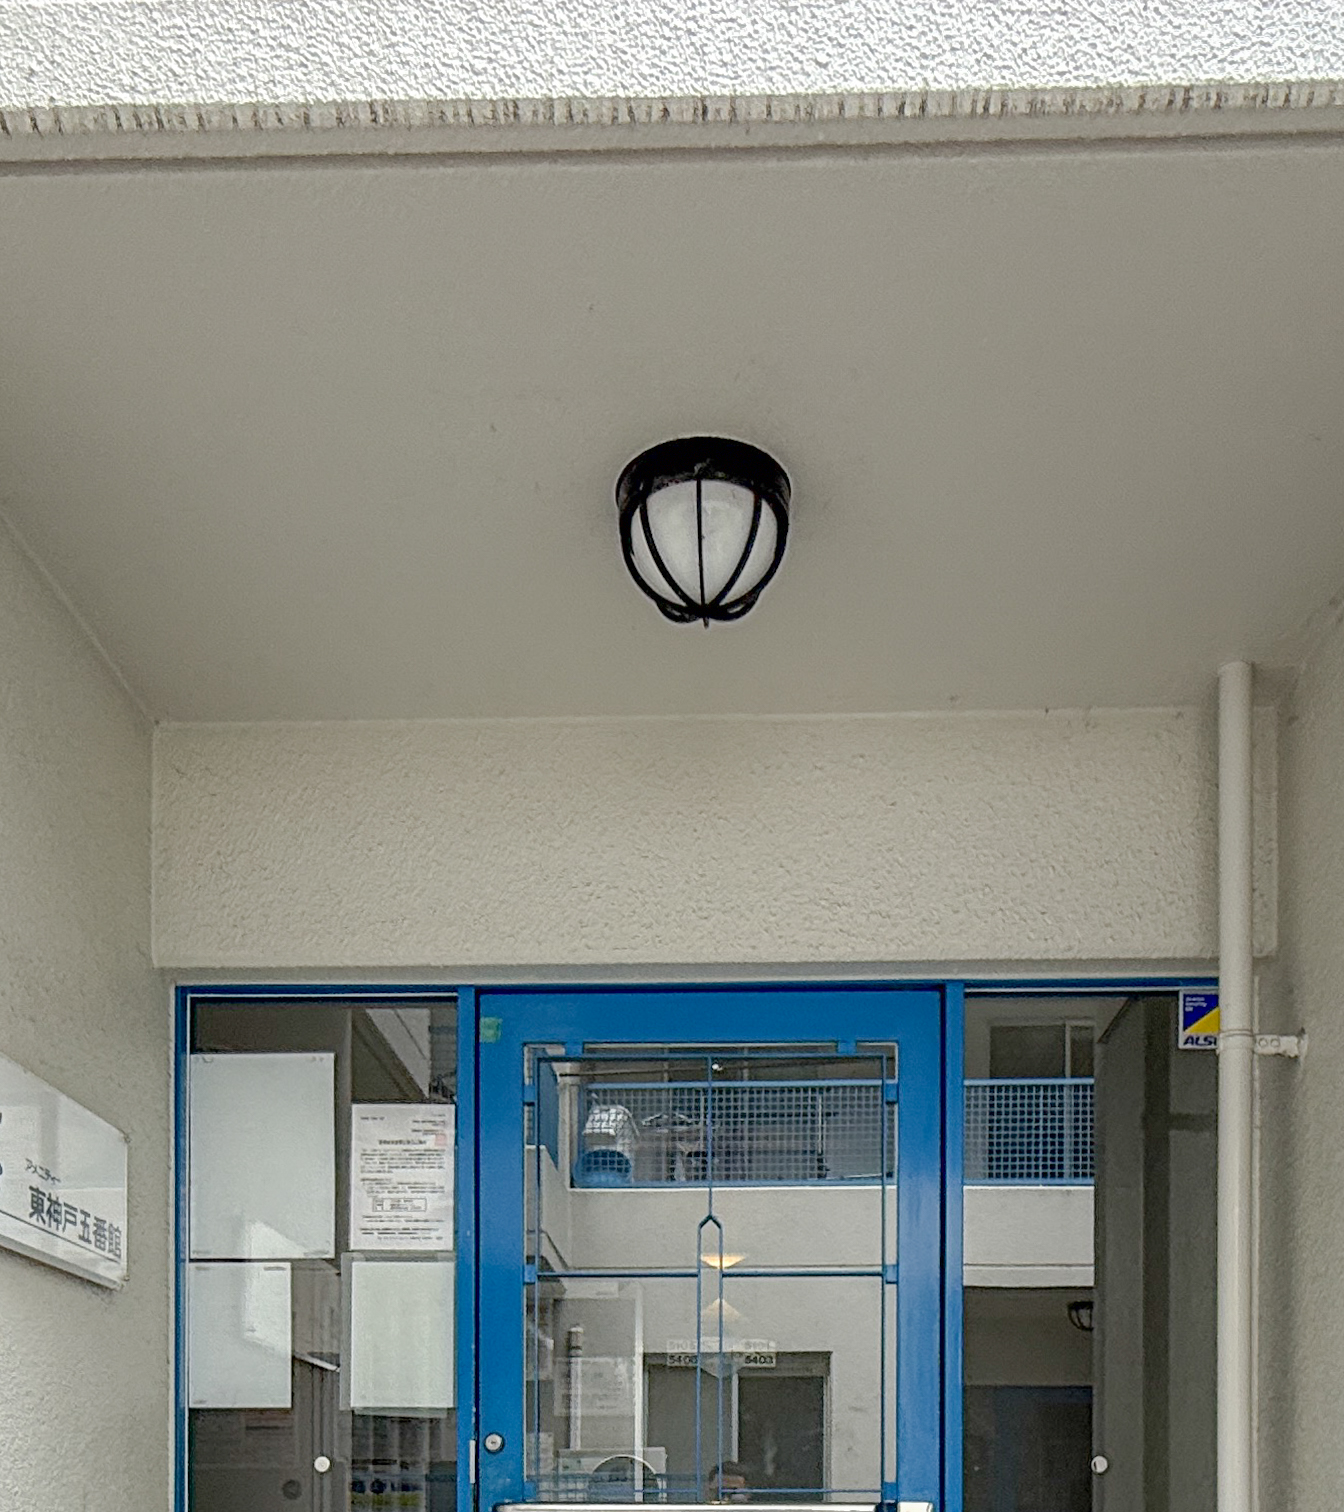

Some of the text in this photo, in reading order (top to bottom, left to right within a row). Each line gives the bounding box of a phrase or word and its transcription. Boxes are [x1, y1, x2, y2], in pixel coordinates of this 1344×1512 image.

[29, 1185, 122, 1259] 東神戸五番館
